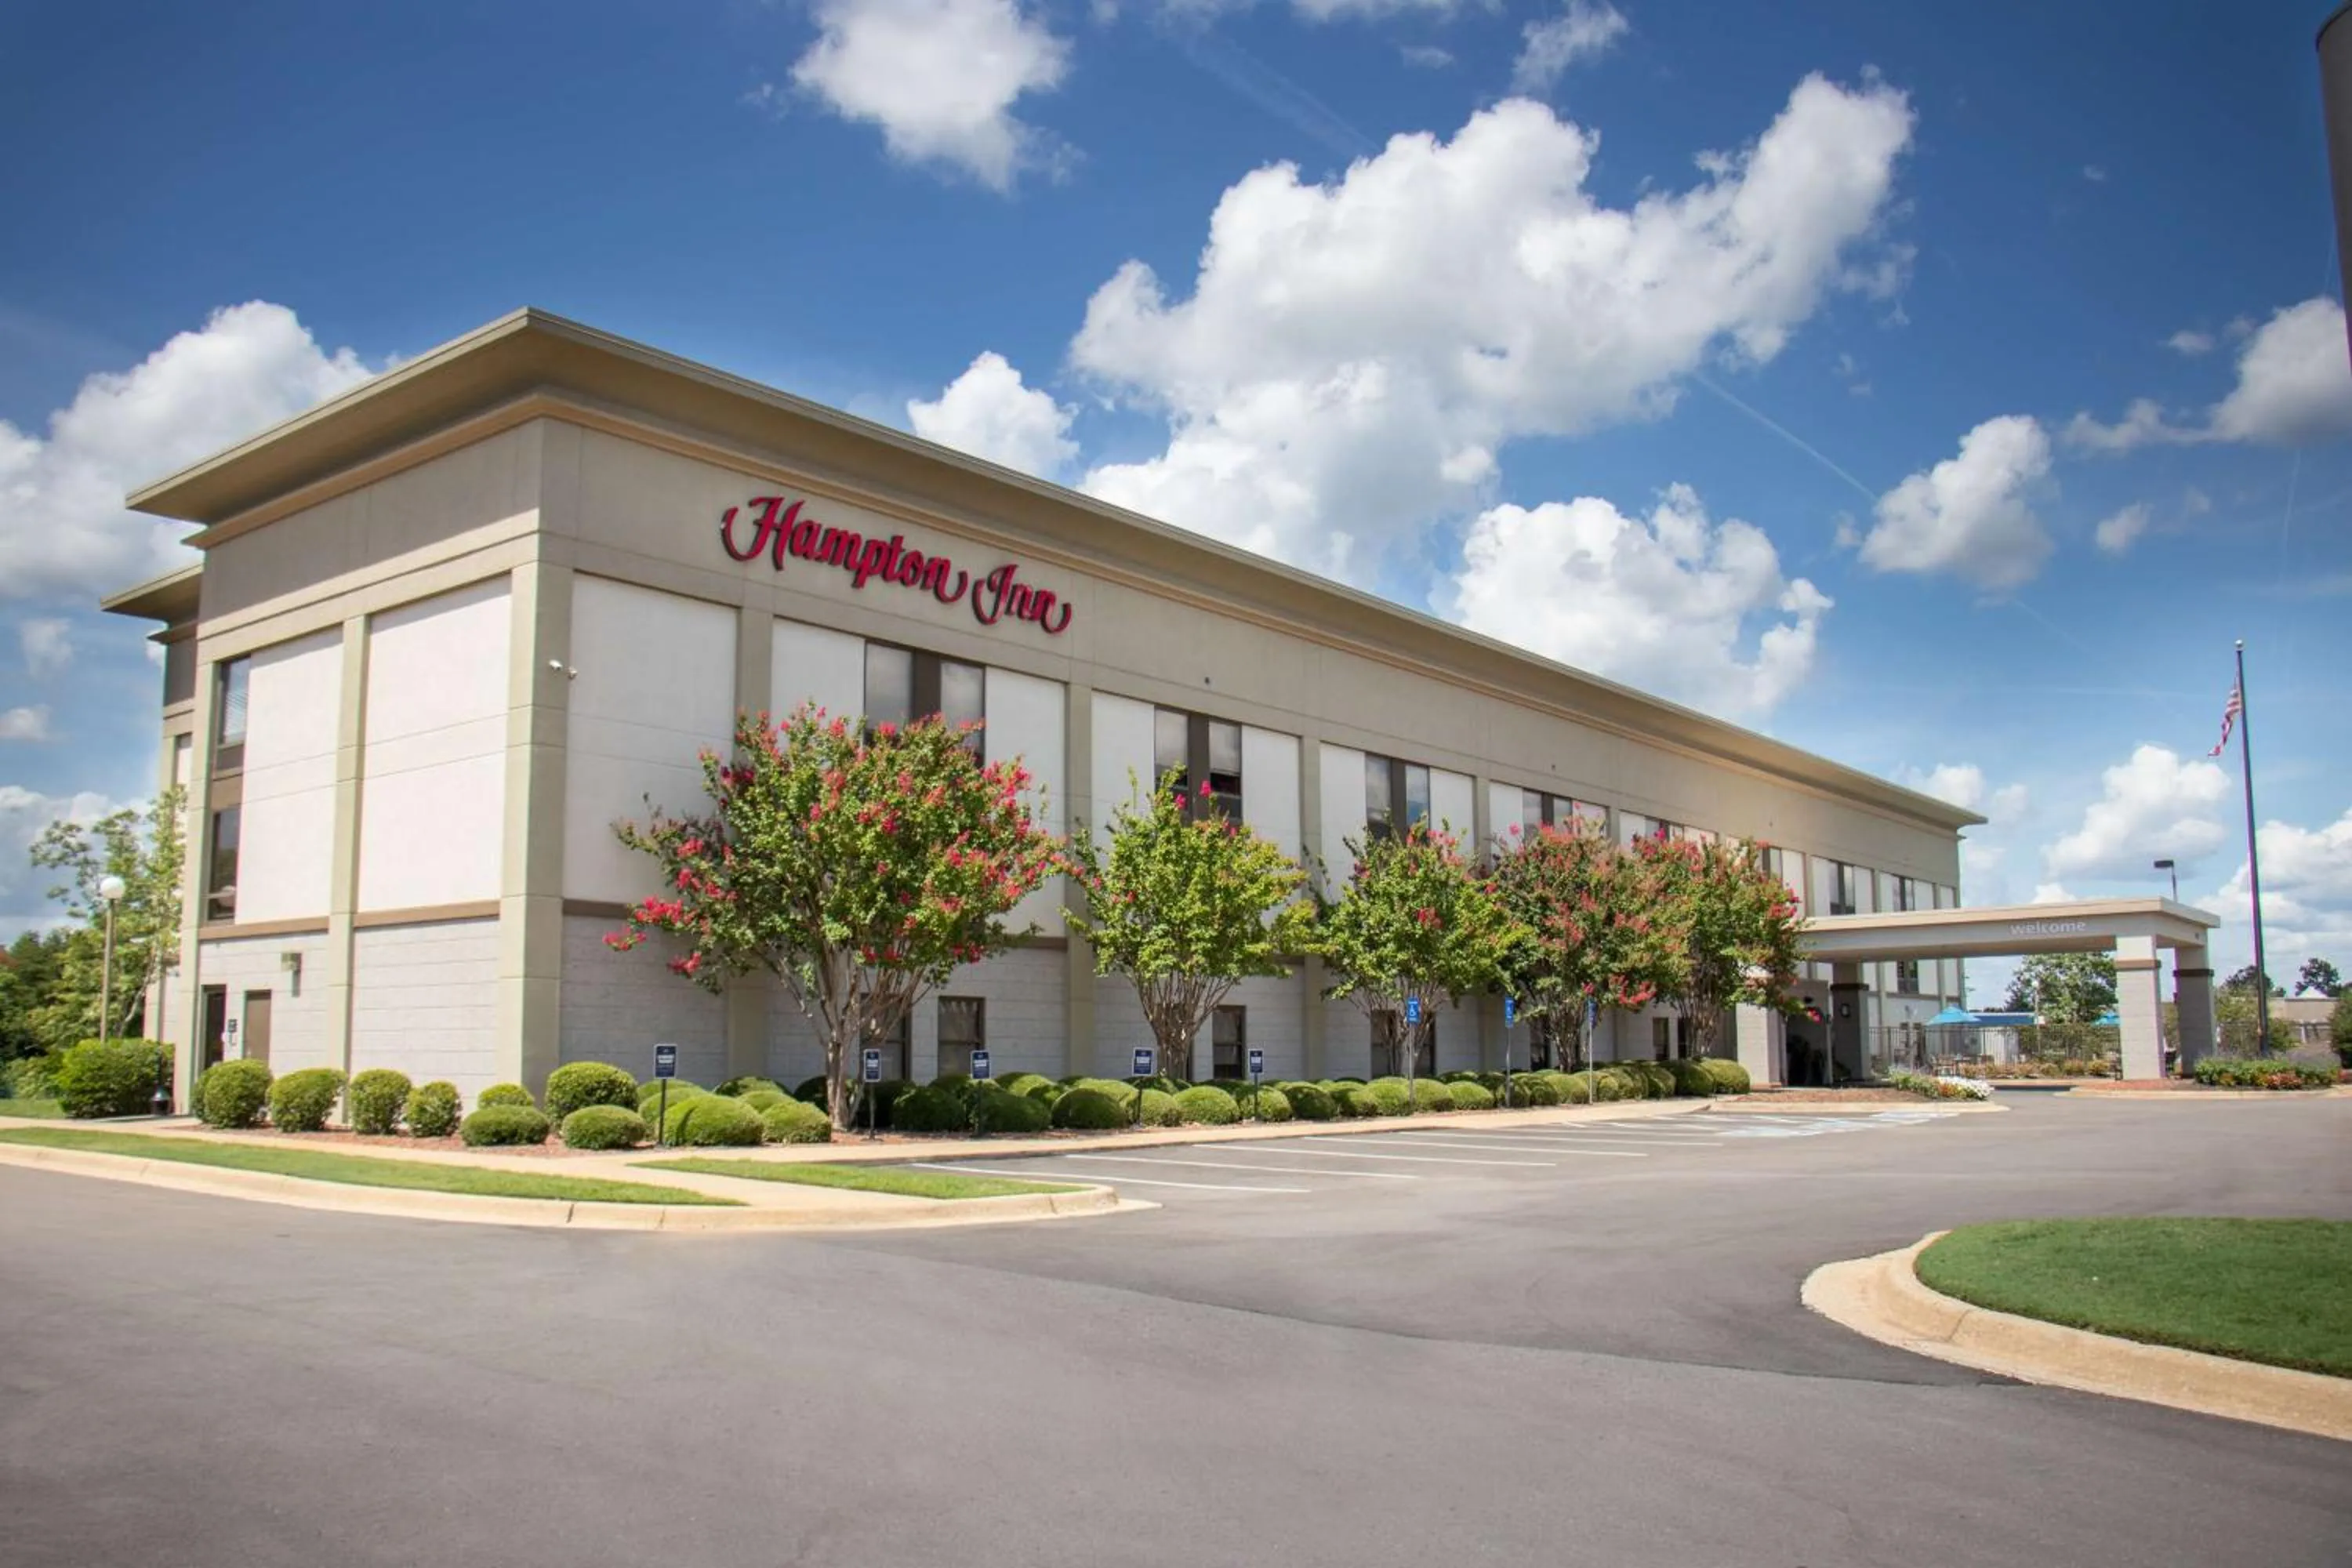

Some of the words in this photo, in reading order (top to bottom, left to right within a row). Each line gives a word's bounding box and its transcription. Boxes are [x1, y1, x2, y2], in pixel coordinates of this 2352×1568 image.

[720, 495, 968, 604] Hampton
[971, 564, 1072, 634] Inn
[2009, 921, 2086, 935] welcome
